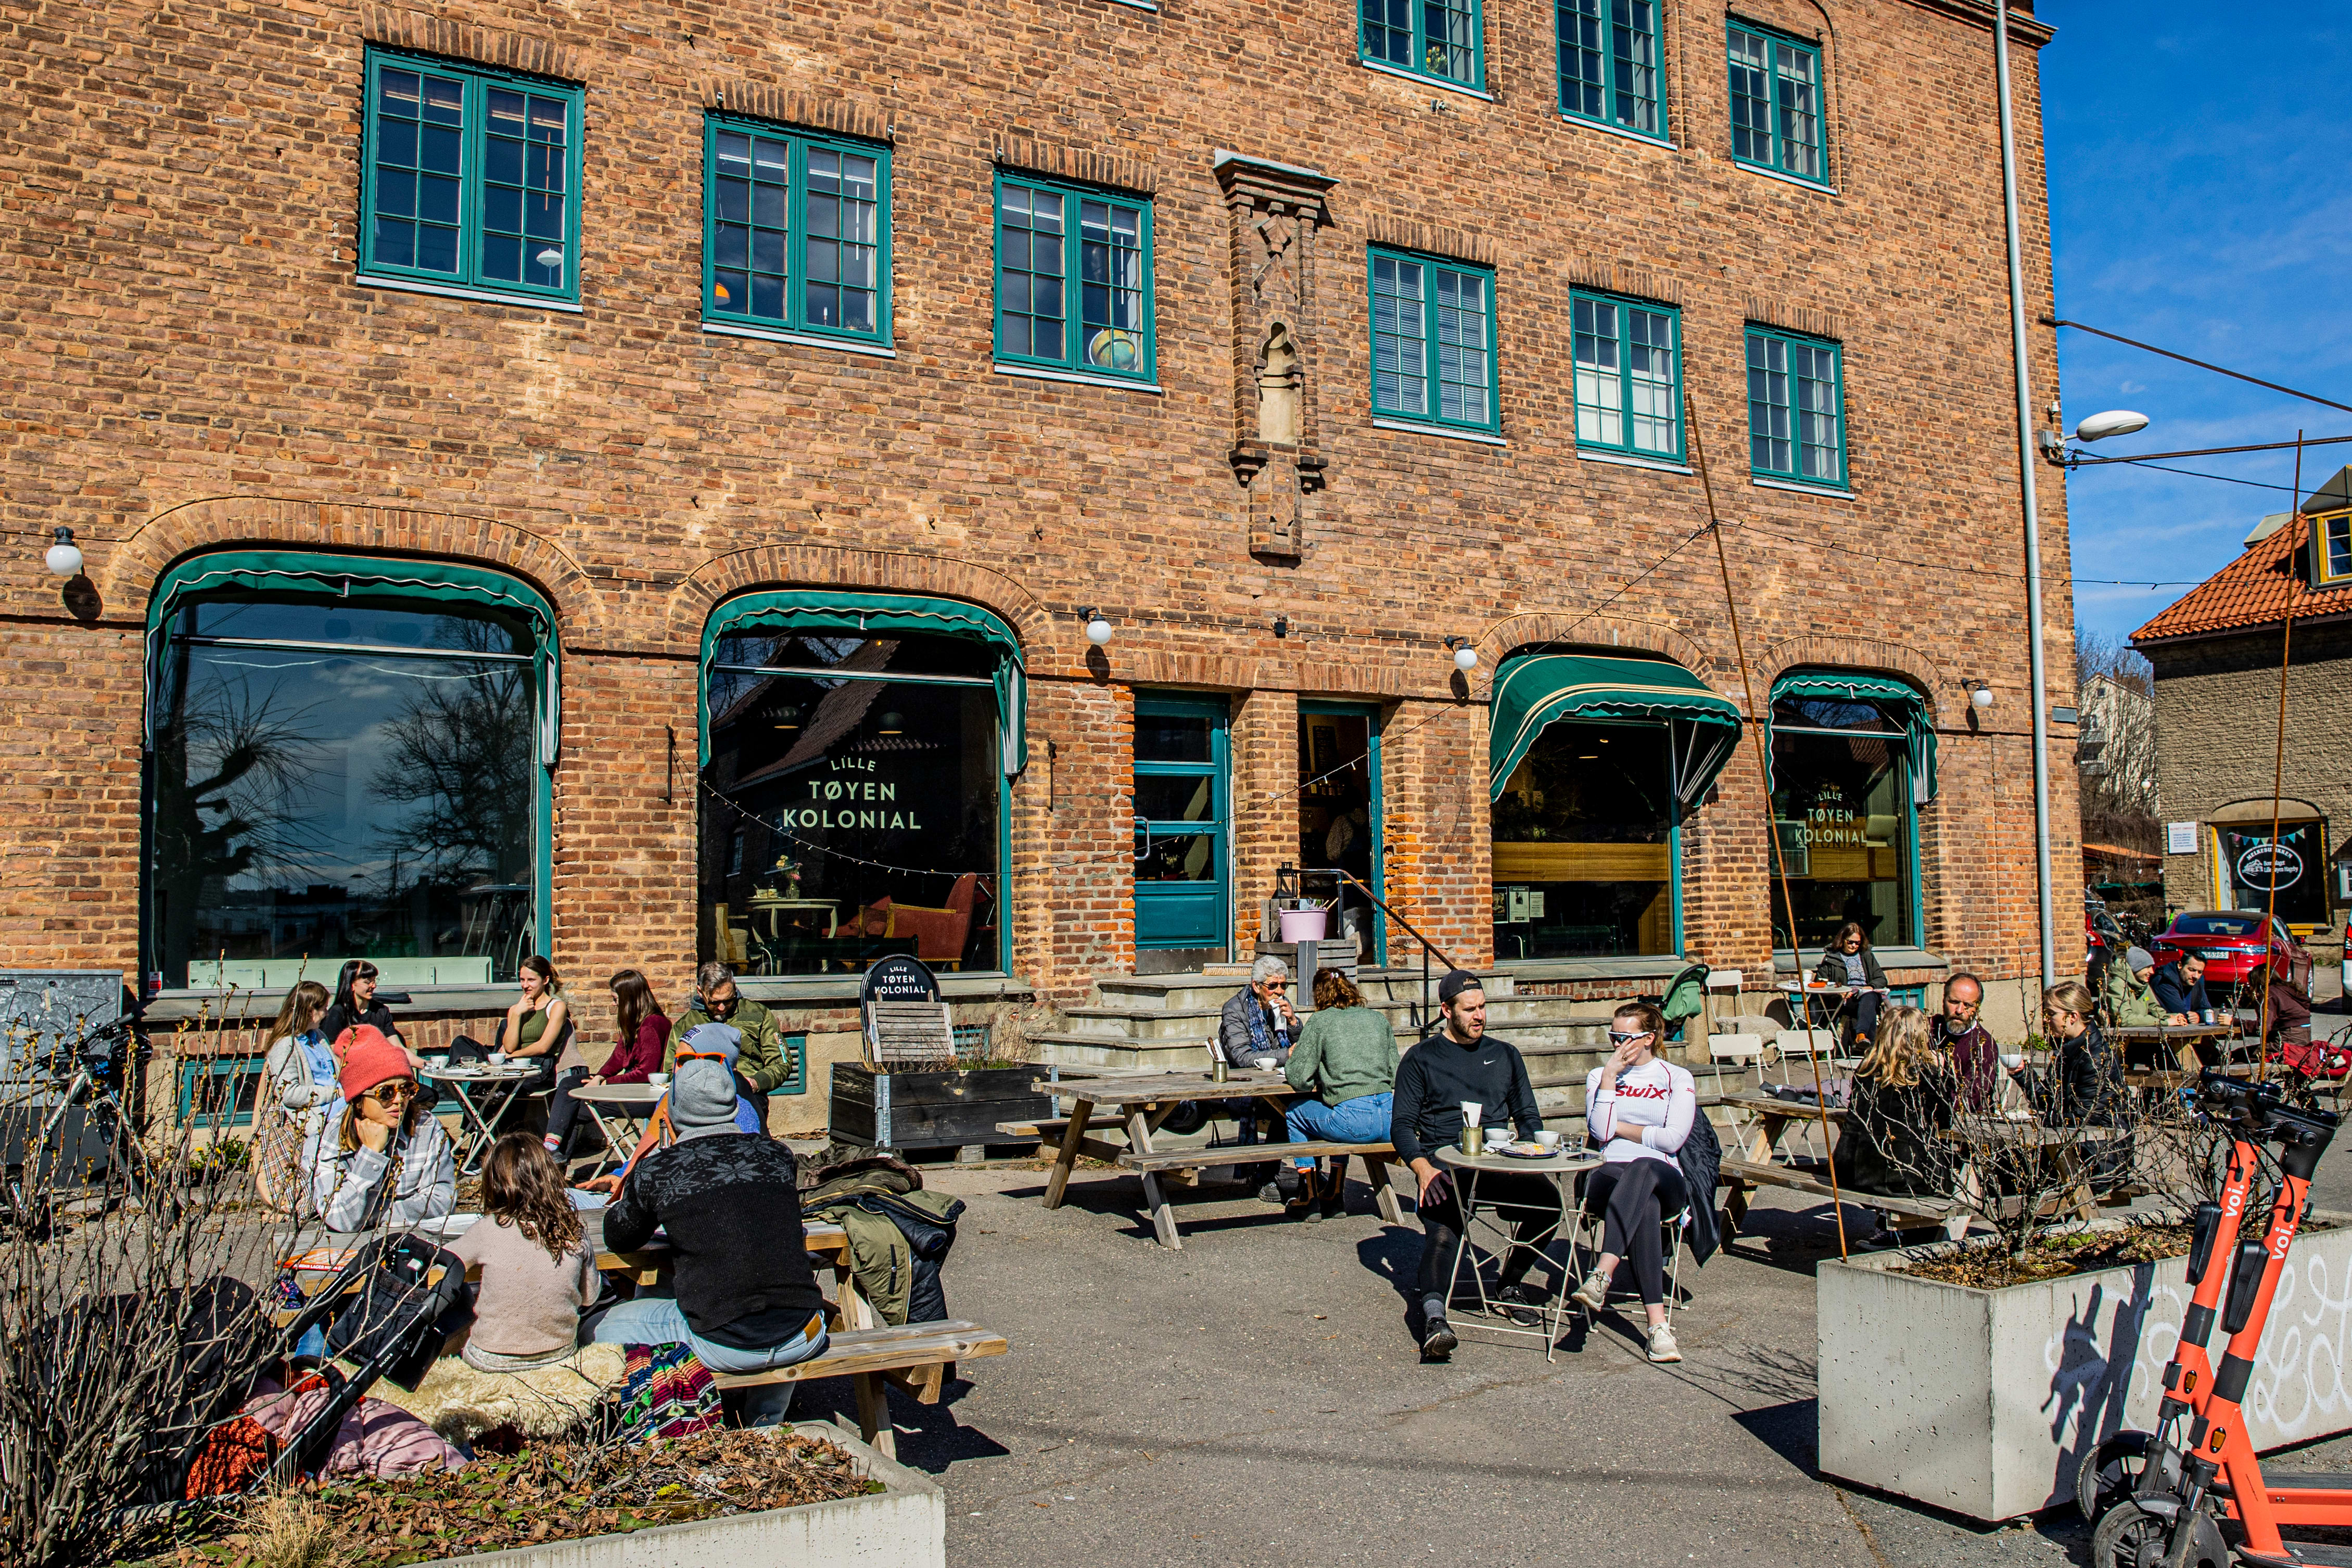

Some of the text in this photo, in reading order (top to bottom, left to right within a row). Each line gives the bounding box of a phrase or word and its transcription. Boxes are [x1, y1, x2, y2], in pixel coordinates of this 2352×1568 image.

[831, 757, 876, 772] LILLE
[809, 781, 895, 800] TØYEN
[1818, 791, 1842, 801] LILLE
[783, 809, 921, 829] KOLONIAL
[1808, 808, 1853, 822] TØYEN
[1795, 828, 1868, 843] KOLONIAL
[2246, 847, 2293, 860] MELKEBUIKKEN
[883, 975, 916, 984] TØYEN
[874, 985, 926, 995] KOLONIAL
[2225, 1184, 2244, 1217] voi.
[2272, 1224, 2294, 1260] voi.
